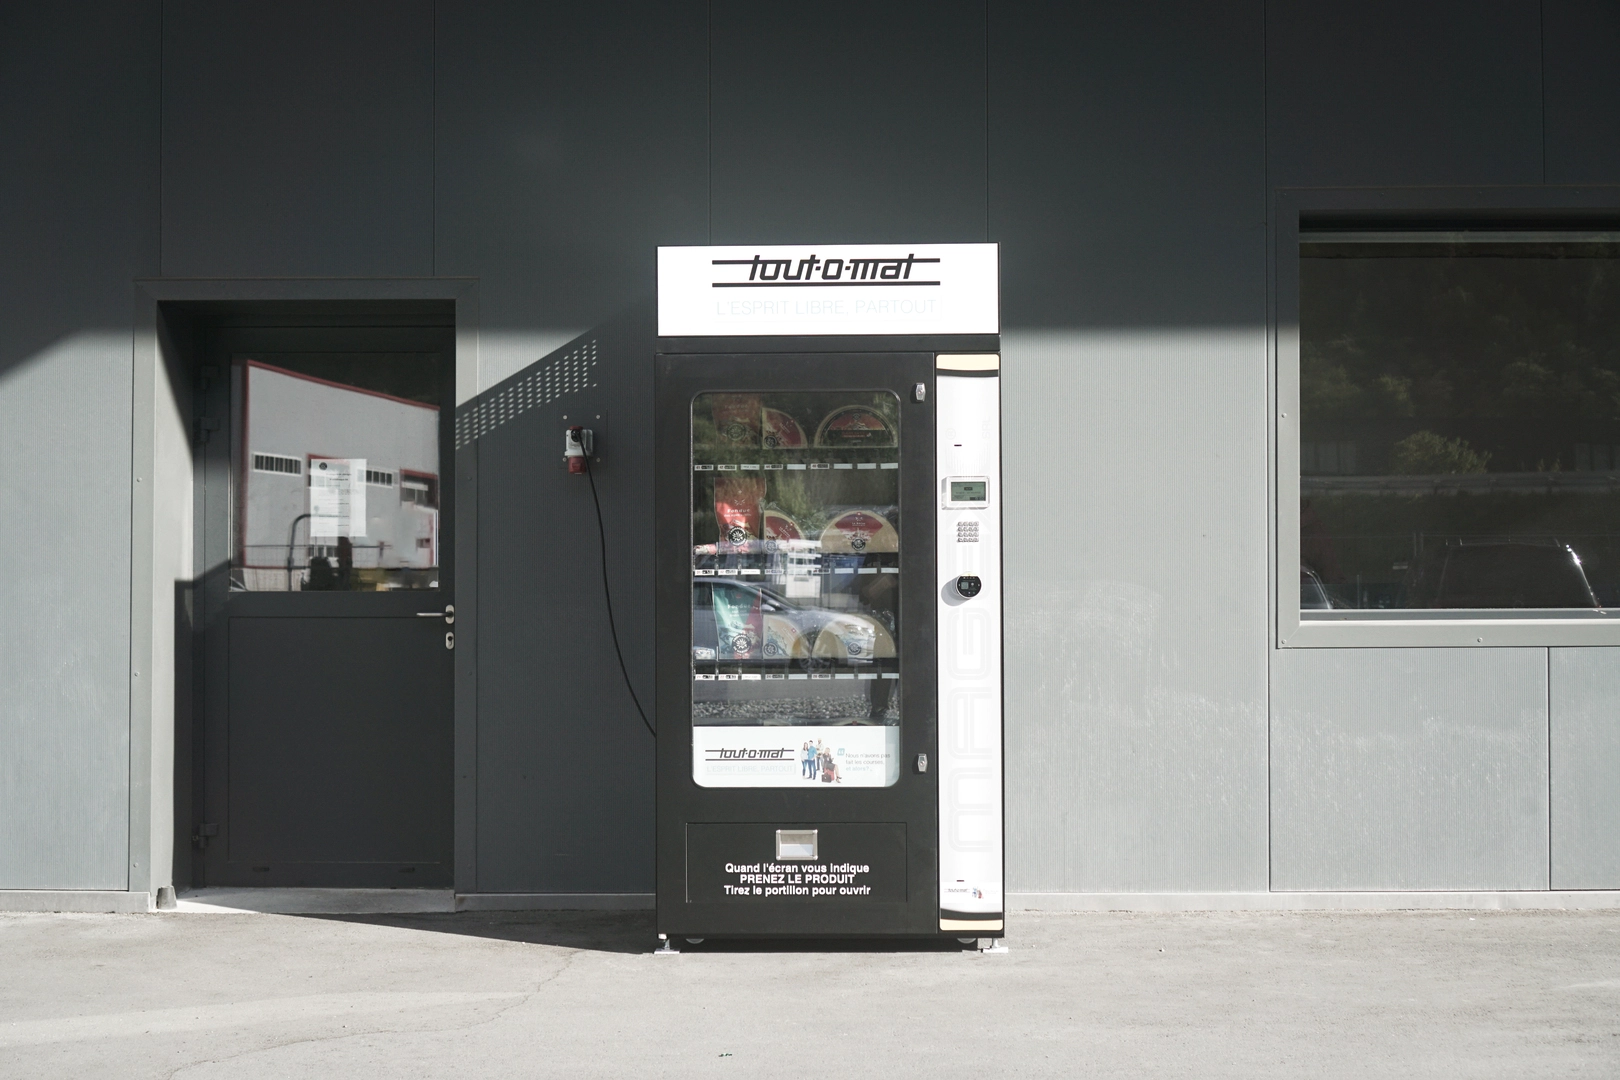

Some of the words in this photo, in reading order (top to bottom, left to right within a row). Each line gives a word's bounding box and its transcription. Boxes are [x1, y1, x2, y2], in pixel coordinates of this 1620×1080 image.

[716, 300, 789, 316] L'ESPRIT
[794, 300, 849, 317] LIBRE,
[855, 299, 937, 315] PARTOUT
[725, 863, 760, 873] Quand
[763, 863, 798, 873] l'écran
[801, 865, 827, 873] vous
[830, 863, 870, 875] indique
[740, 874, 785, 884] PRENEZ
[788, 874, 802, 884] LE
[805, 874, 855, 884] PRODUIT
[724, 885, 750, 895] Tirez
[753, 885, 762, 895] le
[765, 885, 809, 897] portillon
[812, 887, 837, 897] pour
[839, 885, 871, 895] ouvrir
